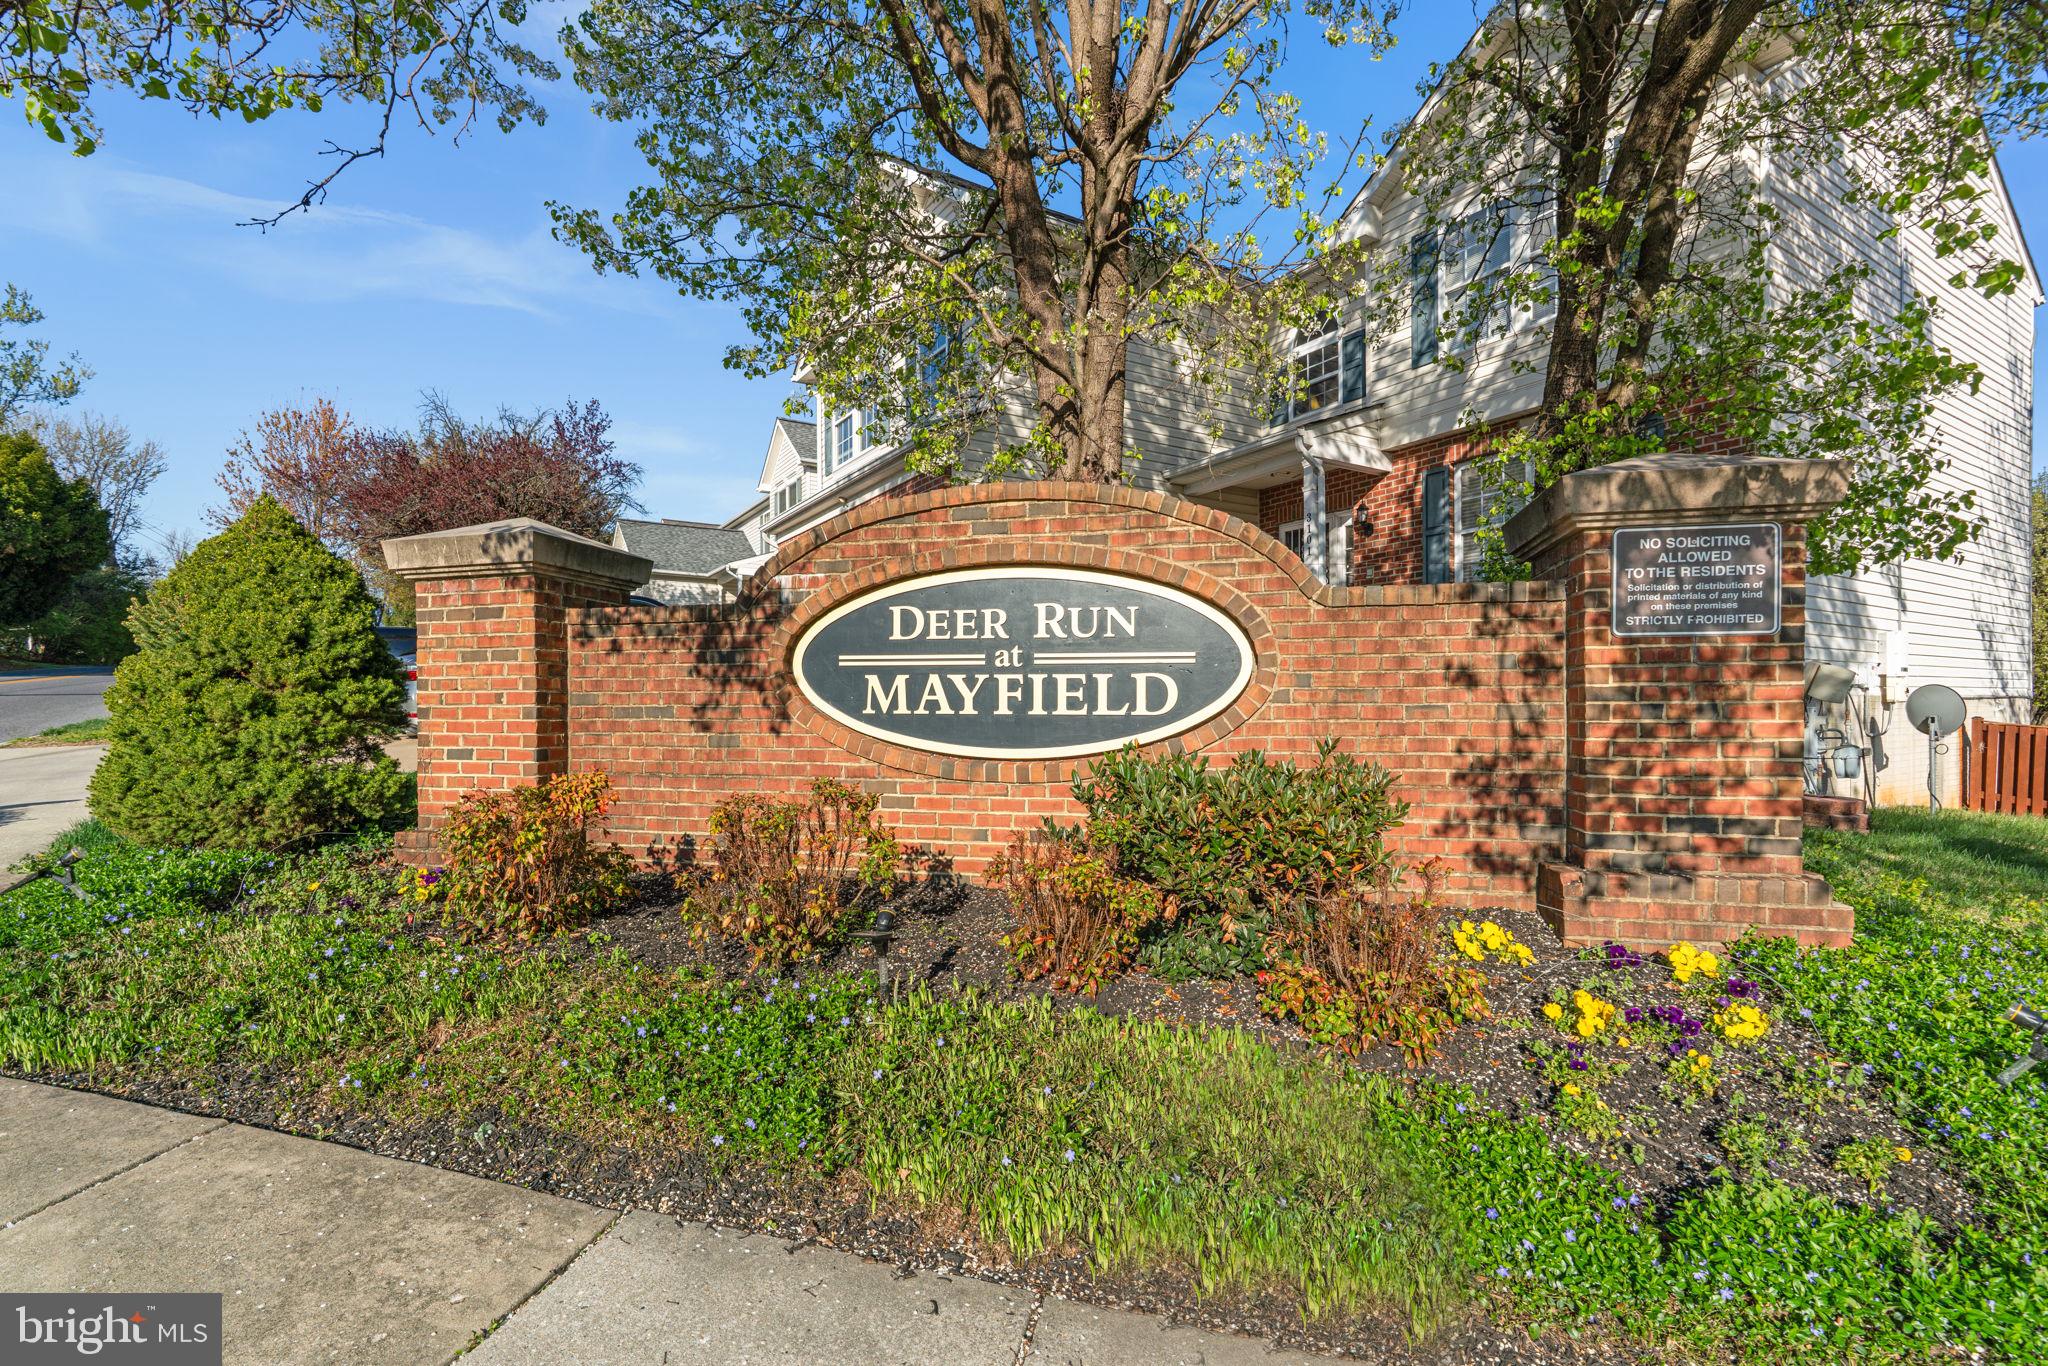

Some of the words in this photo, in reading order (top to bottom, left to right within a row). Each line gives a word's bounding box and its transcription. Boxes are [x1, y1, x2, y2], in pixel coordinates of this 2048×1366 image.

[1640, 538, 1661, 549] NO
[1666, 535, 1751, 549] SOLICITING
[1657, 550, 1732, 563] ALLOWED
[1625, 568, 1644, 579] TO
[1647, 566, 1676, 578] THE
[1681, 564, 1766, 578] RESIDENTS
[1627, 583, 1680, 592] Solicitation
[1695, 581, 1750, 590] distribution
[1753, 580, 1763, 589] of
[1627, 593, 1661, 602] printed
[1663, 592, 1706, 600] materials
[1709, 591, 1719, 599] of
[1721, 592, 1738, 601] any
[1741, 590, 1763, 599] kind
[1650, 603, 1663, 611] on
[1665, 602, 1691, 610] these
[1694, 601, 1738, 611] premises
[889, 604, 1010, 641] DEER
[1033, 602, 1139, 639] RUN
[1625, 615, 1684, 626] STRICTLY
[1688, 613, 1764, 625] PROHIBITED
[994, 645, 1024, 668] at
[862, 672, 1180, 716] MAYFIELD
